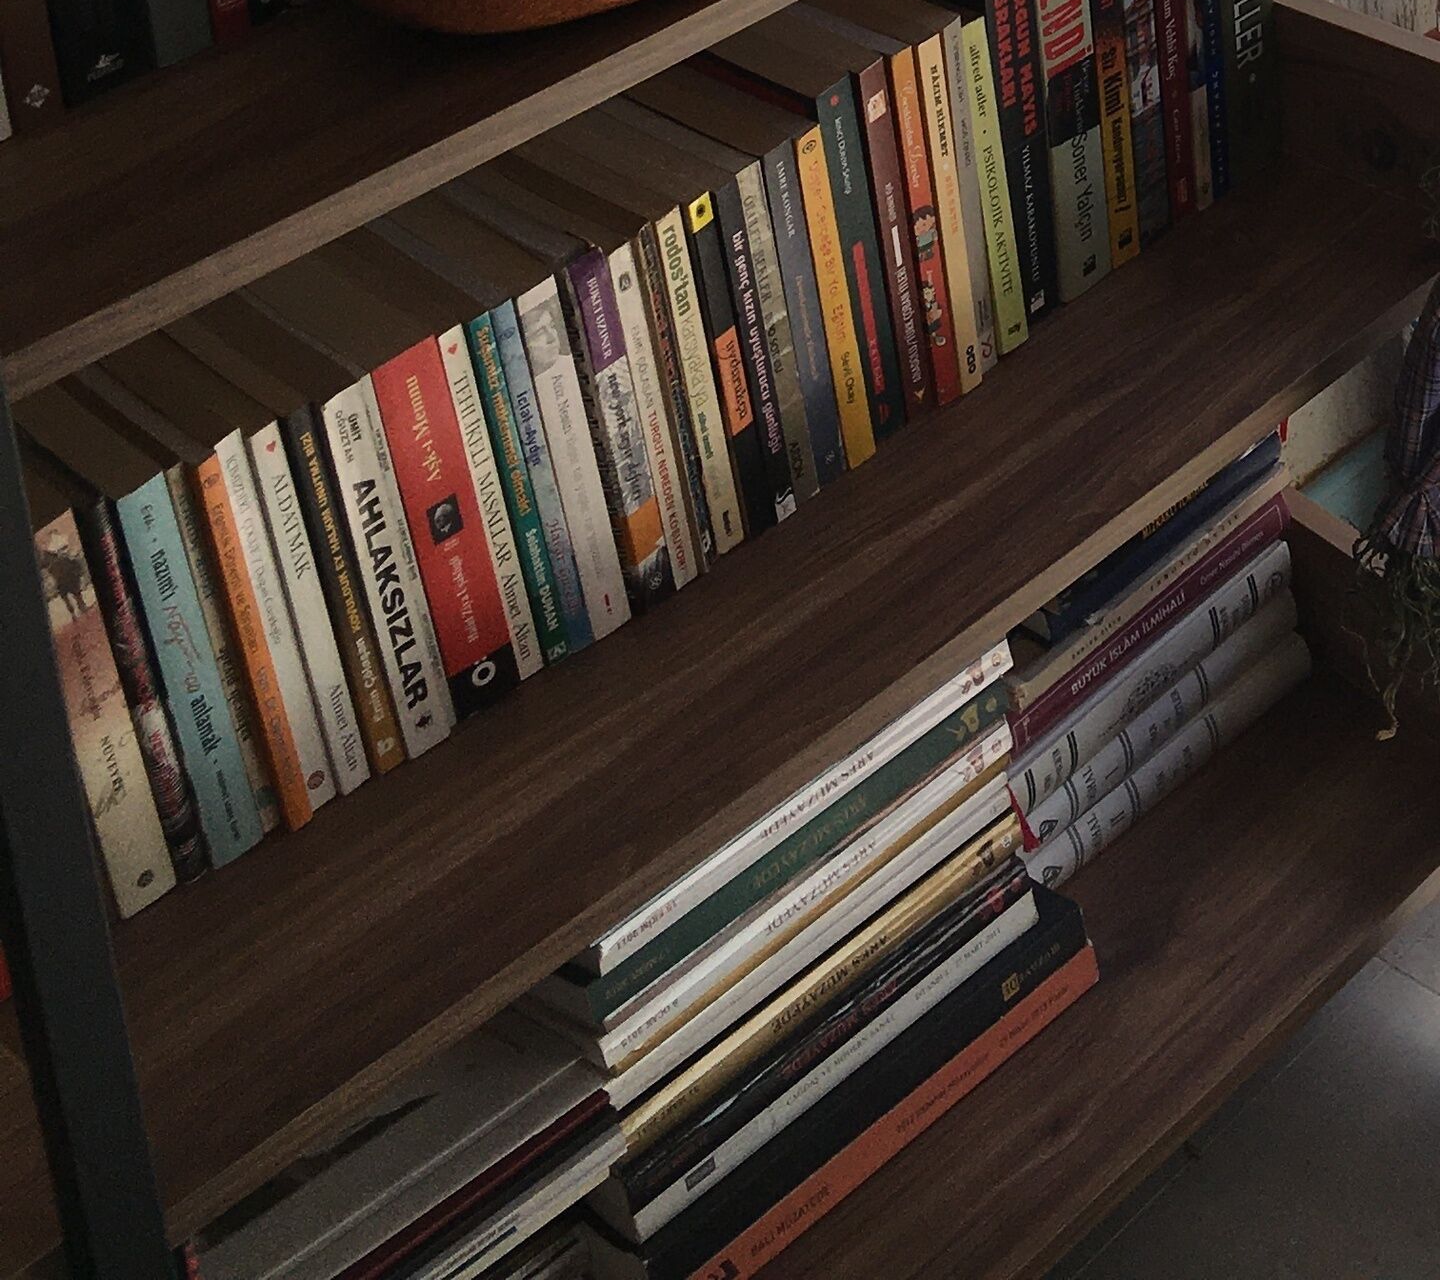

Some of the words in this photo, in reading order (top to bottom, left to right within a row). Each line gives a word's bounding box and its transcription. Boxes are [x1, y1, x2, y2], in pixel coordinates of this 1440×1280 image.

[968, 44, 981, 81] alfred
[974, 84, 989, 118] adler
[1021, 61, 1038, 136] MAYIS
[1102, 73, 1124, 117] Kimi
[1070, 135, 1089, 188] Soner
[1072, 188, 1095, 242] Yalçın
[346, 412, 363, 442] ÜMİT
[404, 375, 430, 437] Memnu
[647, 410, 665, 457] TURGUT
[270, 473, 310, 579] ALDATMAK
[452, 371, 491, 470] TEHLİKELİ
[472, 471, 510, 569] MASALLAR
[498, 572, 522, 620] Ahmet
[510, 623, 533, 662] Altan
[351, 477, 430, 710] AHLAKSIZLAR
[1066, 653, 1111, 697] BÜYÜK
[191, 694, 223, 756] anlamak
